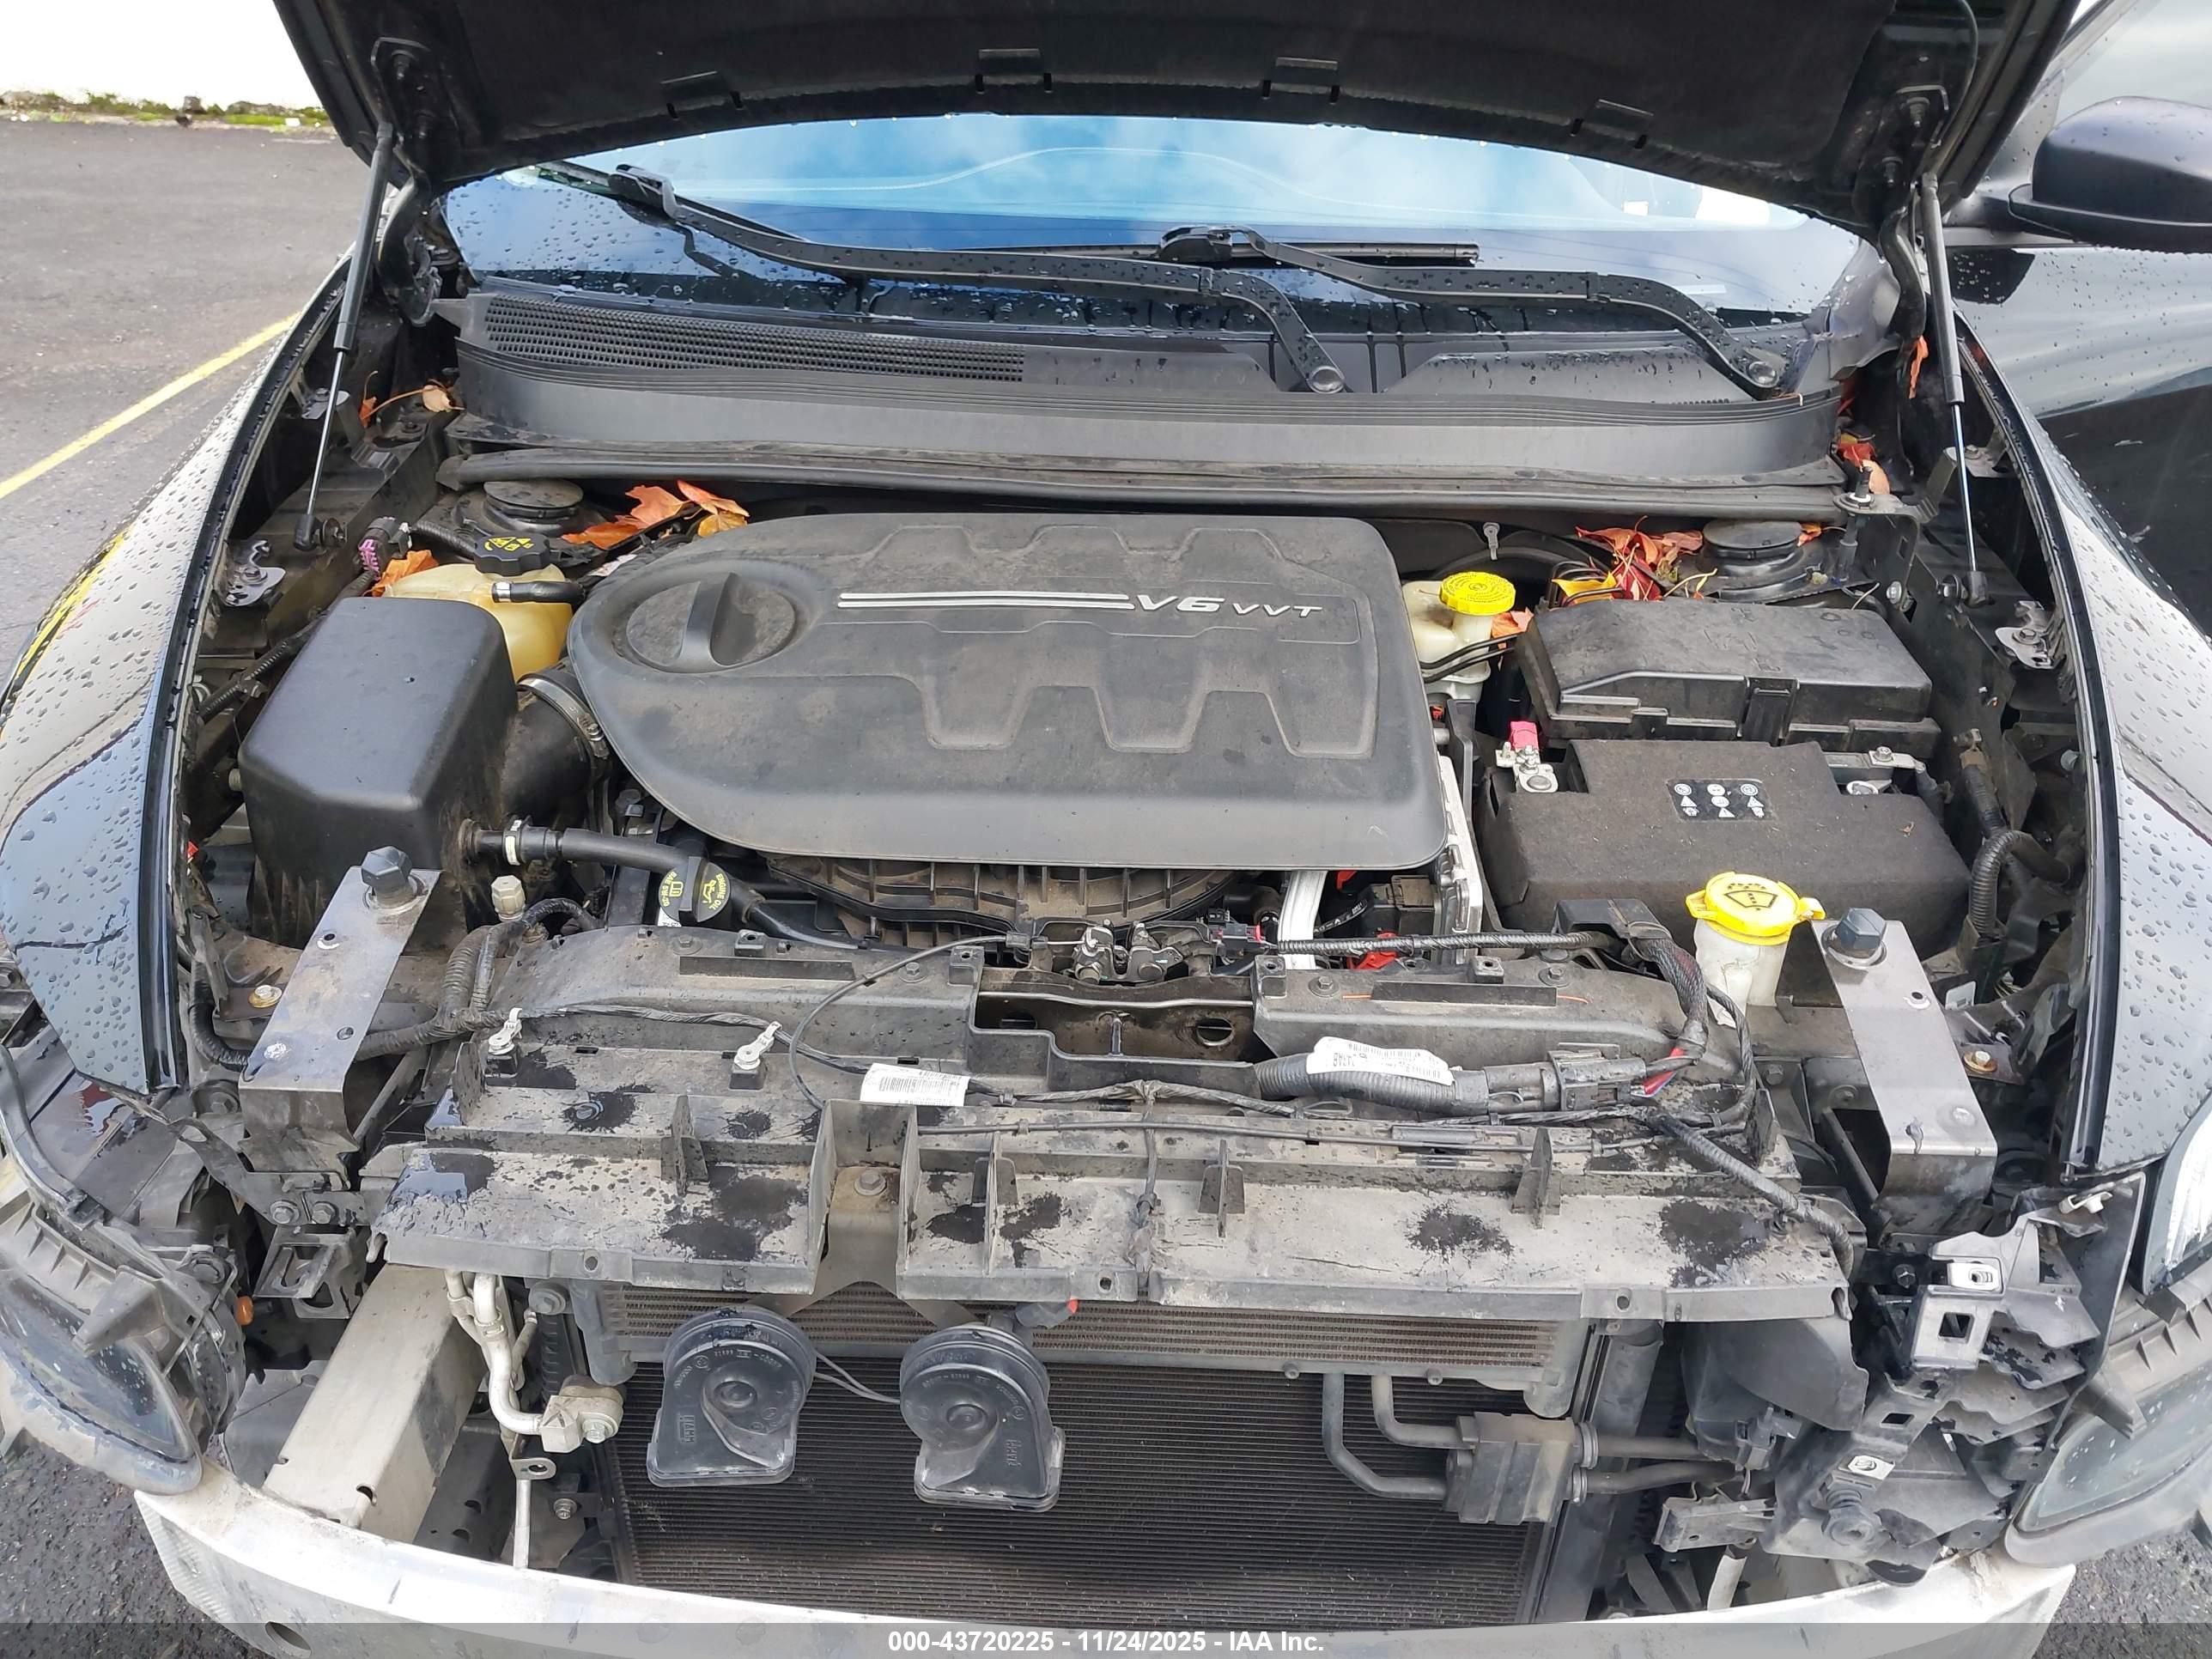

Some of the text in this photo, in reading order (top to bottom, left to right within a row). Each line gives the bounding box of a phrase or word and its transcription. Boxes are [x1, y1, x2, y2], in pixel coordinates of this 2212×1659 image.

[1137, 594, 1323, 617] V6 VVT
[708, 872, 727, 910] ENGINE OIL
